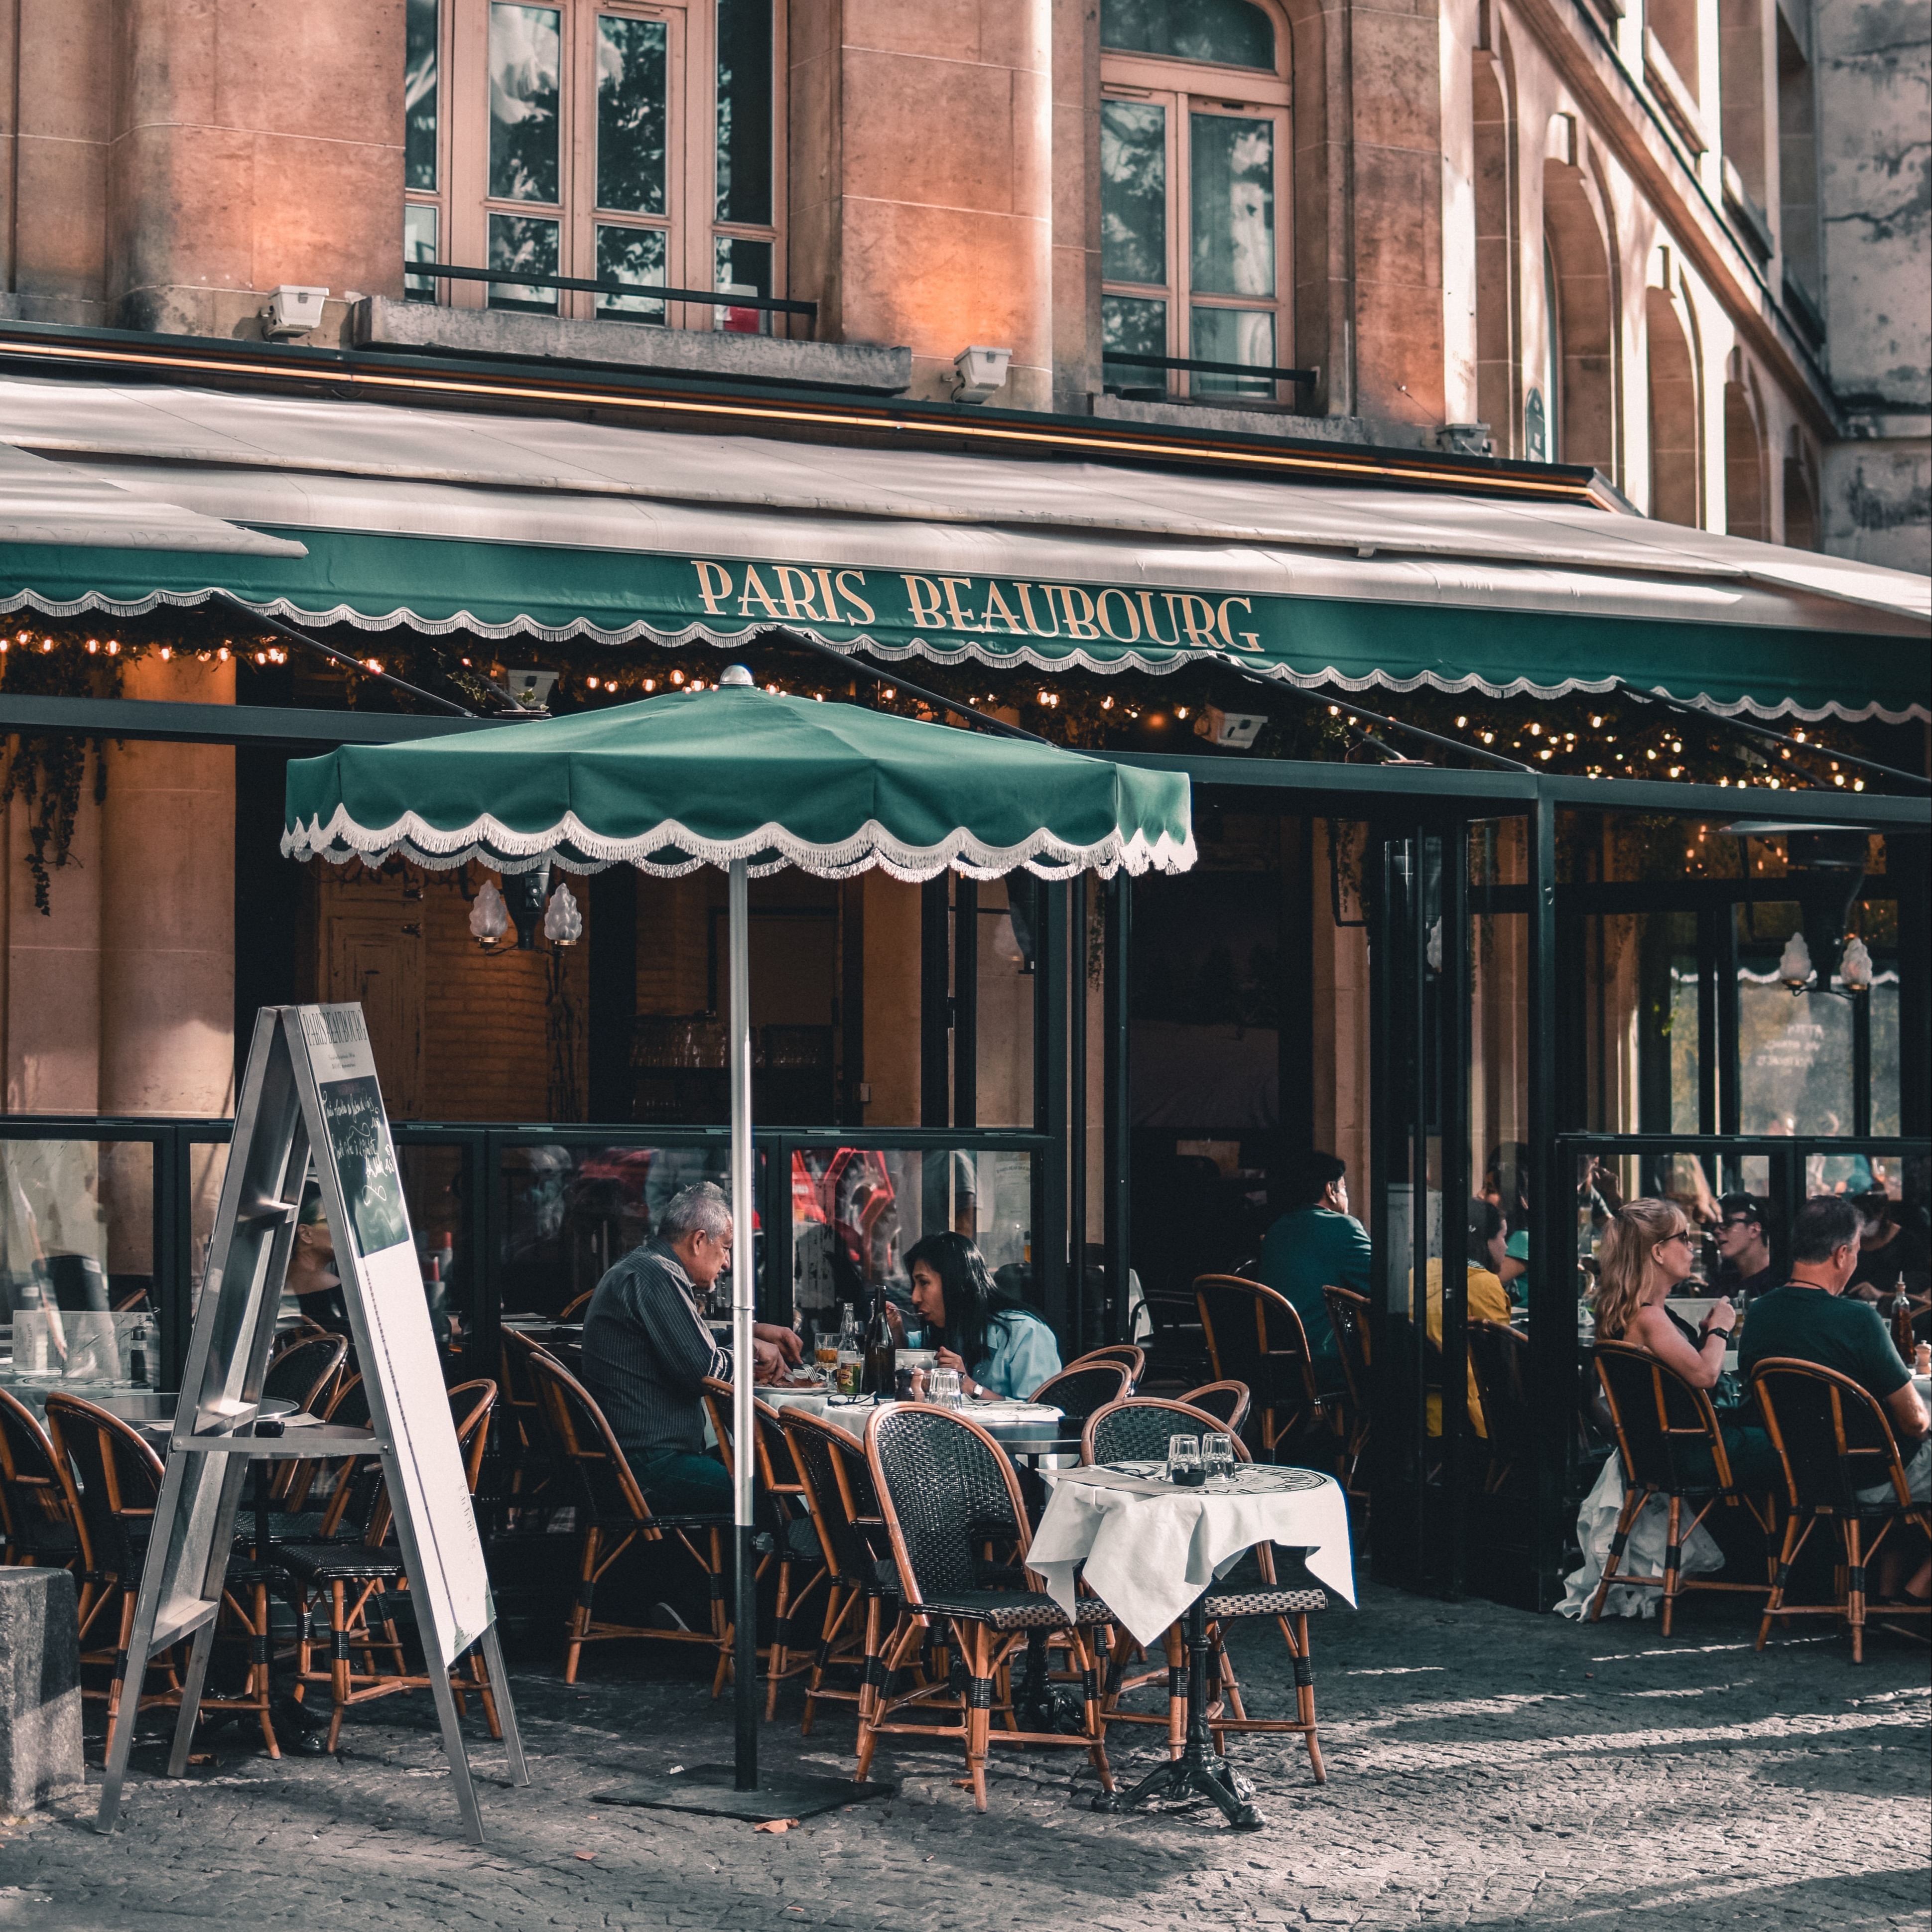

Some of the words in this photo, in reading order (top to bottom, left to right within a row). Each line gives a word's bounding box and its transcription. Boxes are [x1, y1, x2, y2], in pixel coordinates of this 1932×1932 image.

[691, 560, 875, 626] PARIS
[901, 575, 1265, 652] BEAUBOURG
[302, 1013, 327, 1046] PARIS
[323, 1010, 367, 1043] BEAUBOURG
